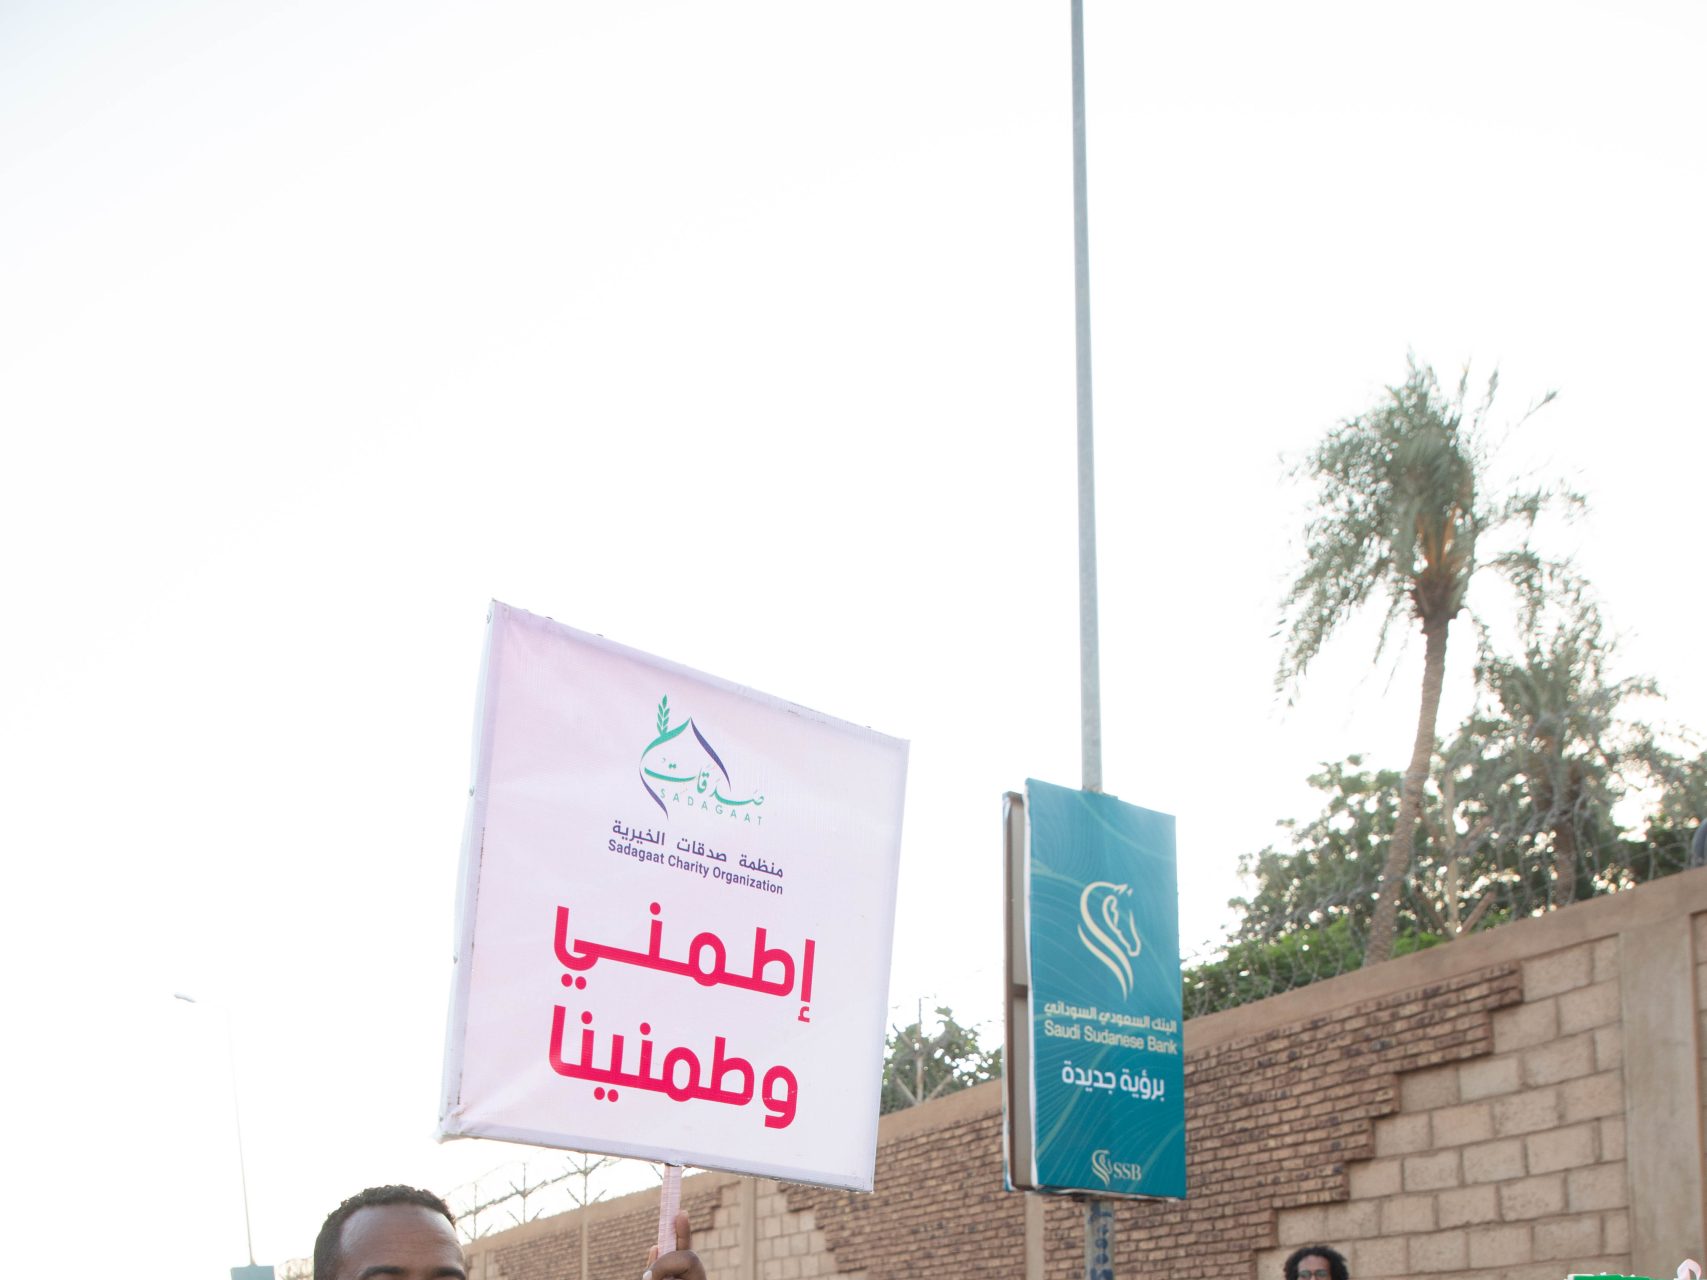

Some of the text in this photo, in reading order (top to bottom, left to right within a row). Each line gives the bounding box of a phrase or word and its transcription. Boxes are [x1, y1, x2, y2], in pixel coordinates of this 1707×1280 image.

[659, 788, 763, 826] SADAGAAT
[608, 838, 784, 895] Sadagaat Charity Organization
[612, 819, 784, 879] منظمة صدقات الخيرية
[553, 902, 816, 1023] إطمني
[1043, 1019, 1178, 1055] Saudi Sudanese Bank
[1044, 1000, 1177, 1035] البنك السعودي السوداني
[548, 1004, 798, 1129] وطمنينا
[1061, 1060, 1166, 1102] برؤية جديدة
[1113, 1161, 1142, 1181] SSB
